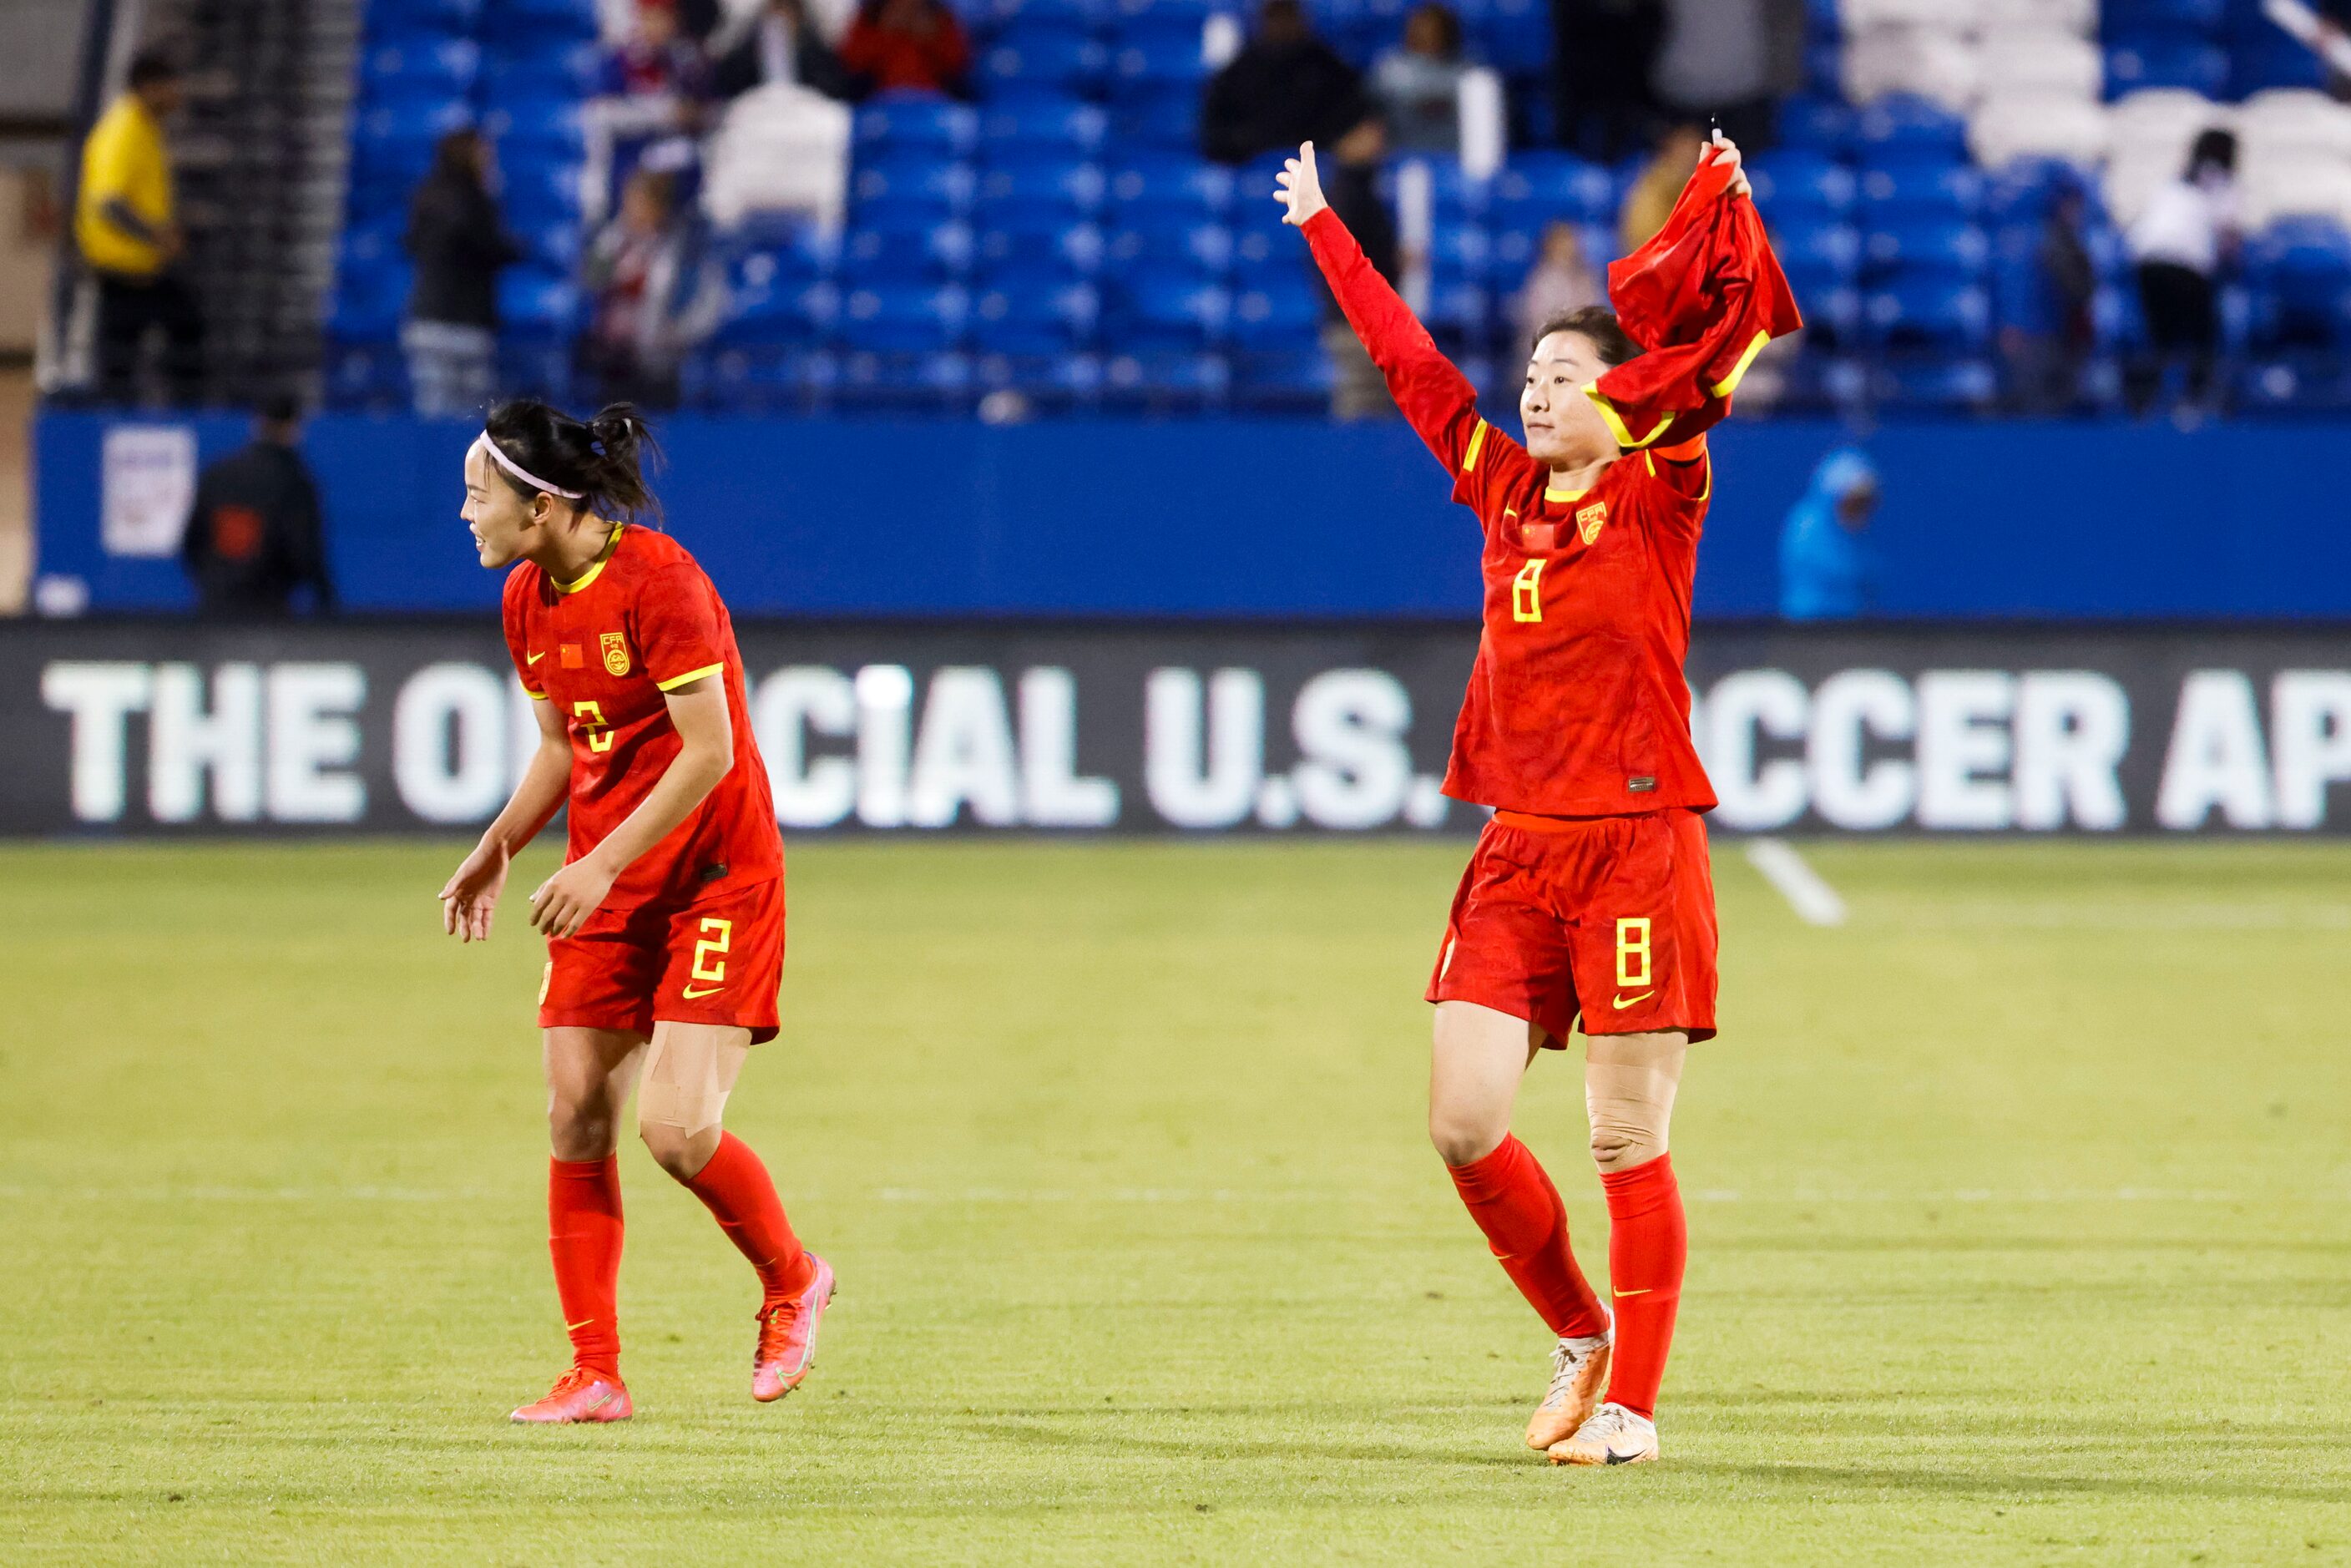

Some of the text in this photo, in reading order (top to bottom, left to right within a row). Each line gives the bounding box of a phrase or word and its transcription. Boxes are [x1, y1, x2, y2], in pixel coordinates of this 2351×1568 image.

[1513, 559, 1547, 623] 8
[603, 635, 624, 645] CFA
[42, 661, 2351, 829] THE OCIAL U.S. CCER AP
[574, 701, 615, 753] 2
[691, 917, 732, 982] 2
[1616, 918, 1651, 987] 8
